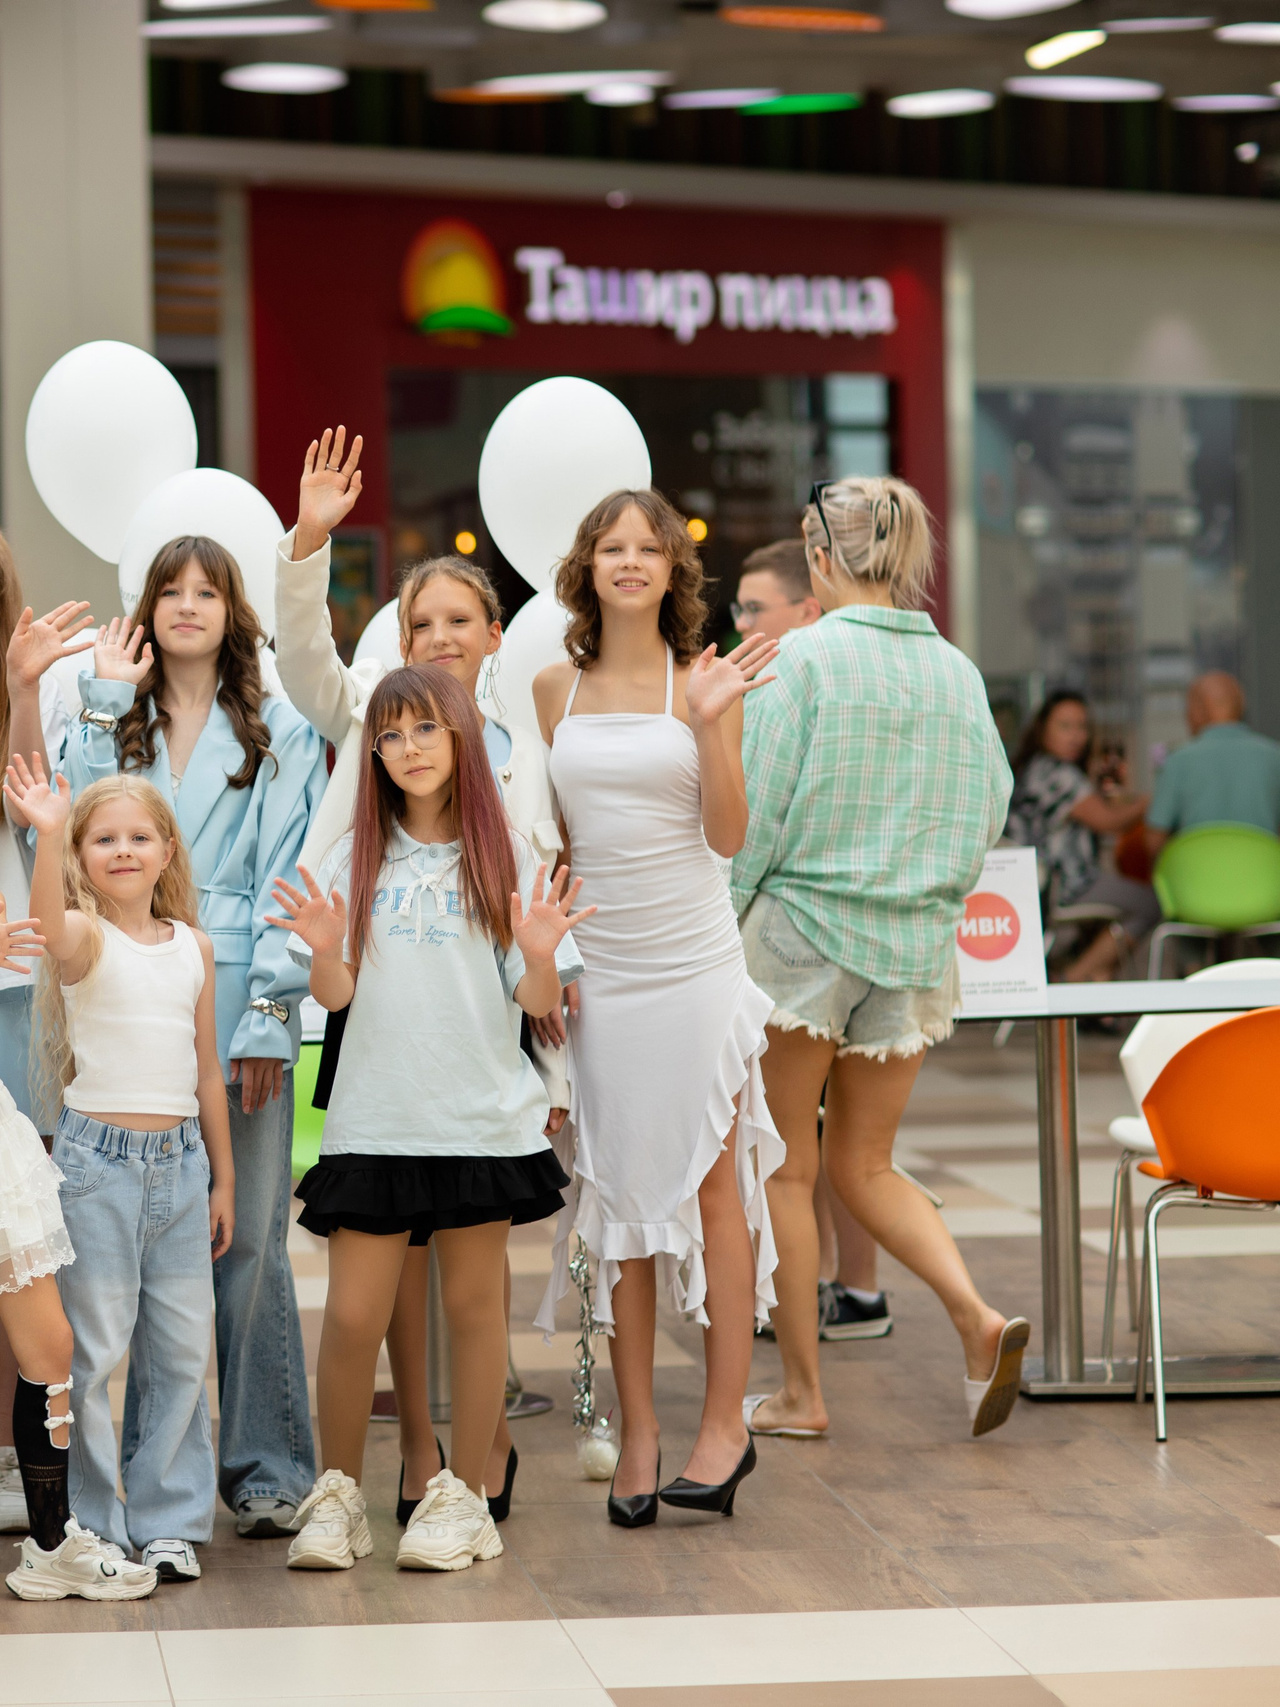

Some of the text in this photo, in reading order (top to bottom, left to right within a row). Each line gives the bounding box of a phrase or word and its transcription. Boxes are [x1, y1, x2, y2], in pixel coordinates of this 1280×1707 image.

[516, 247, 896, 343] Ташир пицца
[425, 925, 460, 938] Ipsum
